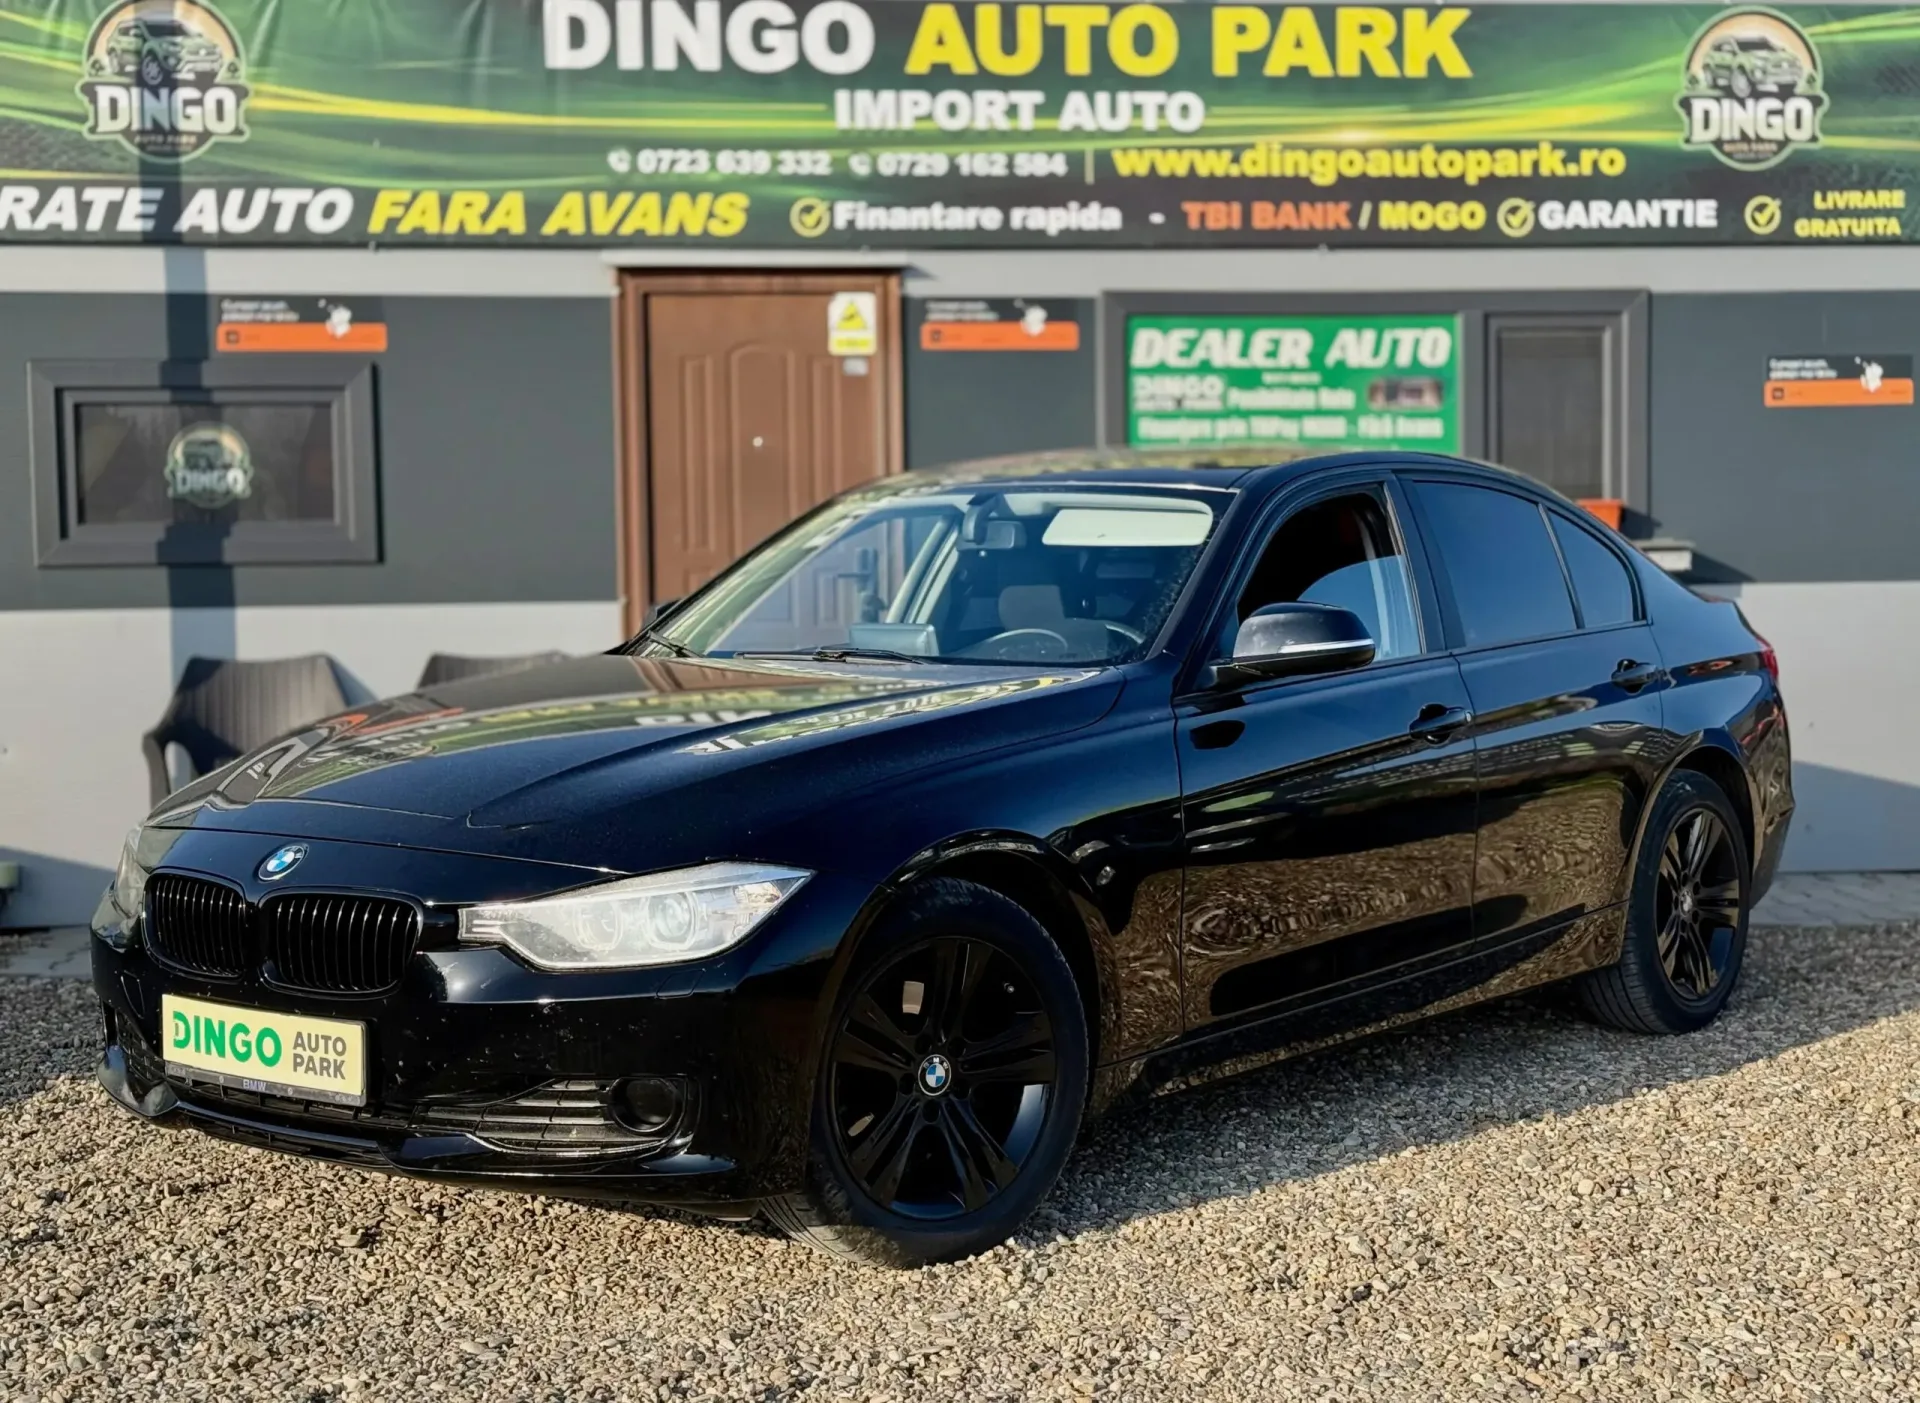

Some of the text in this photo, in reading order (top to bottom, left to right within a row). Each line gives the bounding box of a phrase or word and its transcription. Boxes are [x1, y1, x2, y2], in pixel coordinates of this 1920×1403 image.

[543, 0, 1473, 78] DINGO AUTO PARK
[95, 85, 237, 134] DINGO
[833, 89, 1205, 132] IMPORT AUTO
[1690, 97, 1813, 142] DINGO
[636, 149, 711, 174] 0723
[777, 150, 832, 176] 332
[1112, 141, 1626, 186] www.dingoautopark.ro
[0, 185, 750, 237] RATE AUTO FARA AVANS
[833, 201, 1004, 231] Finantare
[1010, 200, 1122, 237] rapida
[1181, 201, 1242, 230] TBI
[1251, 201, 1352, 231] BANK
[1378, 200, 1487, 231] MOGO
[1538, 200, 1718, 230] GARANTIE
[1814, 191, 1905, 209] LIVRARE
[1794, 217, 1901, 237] GRATUITA
[1130, 327, 1453, 369] DEALER AUTO
[176, 468, 245, 494] DINGO
[173, 1010, 282, 1068] DINGO
[293, 1031, 347, 1056] AUTO
[293, 1053, 346, 1080] PARK
[243, 1079, 267, 1092] BMW
